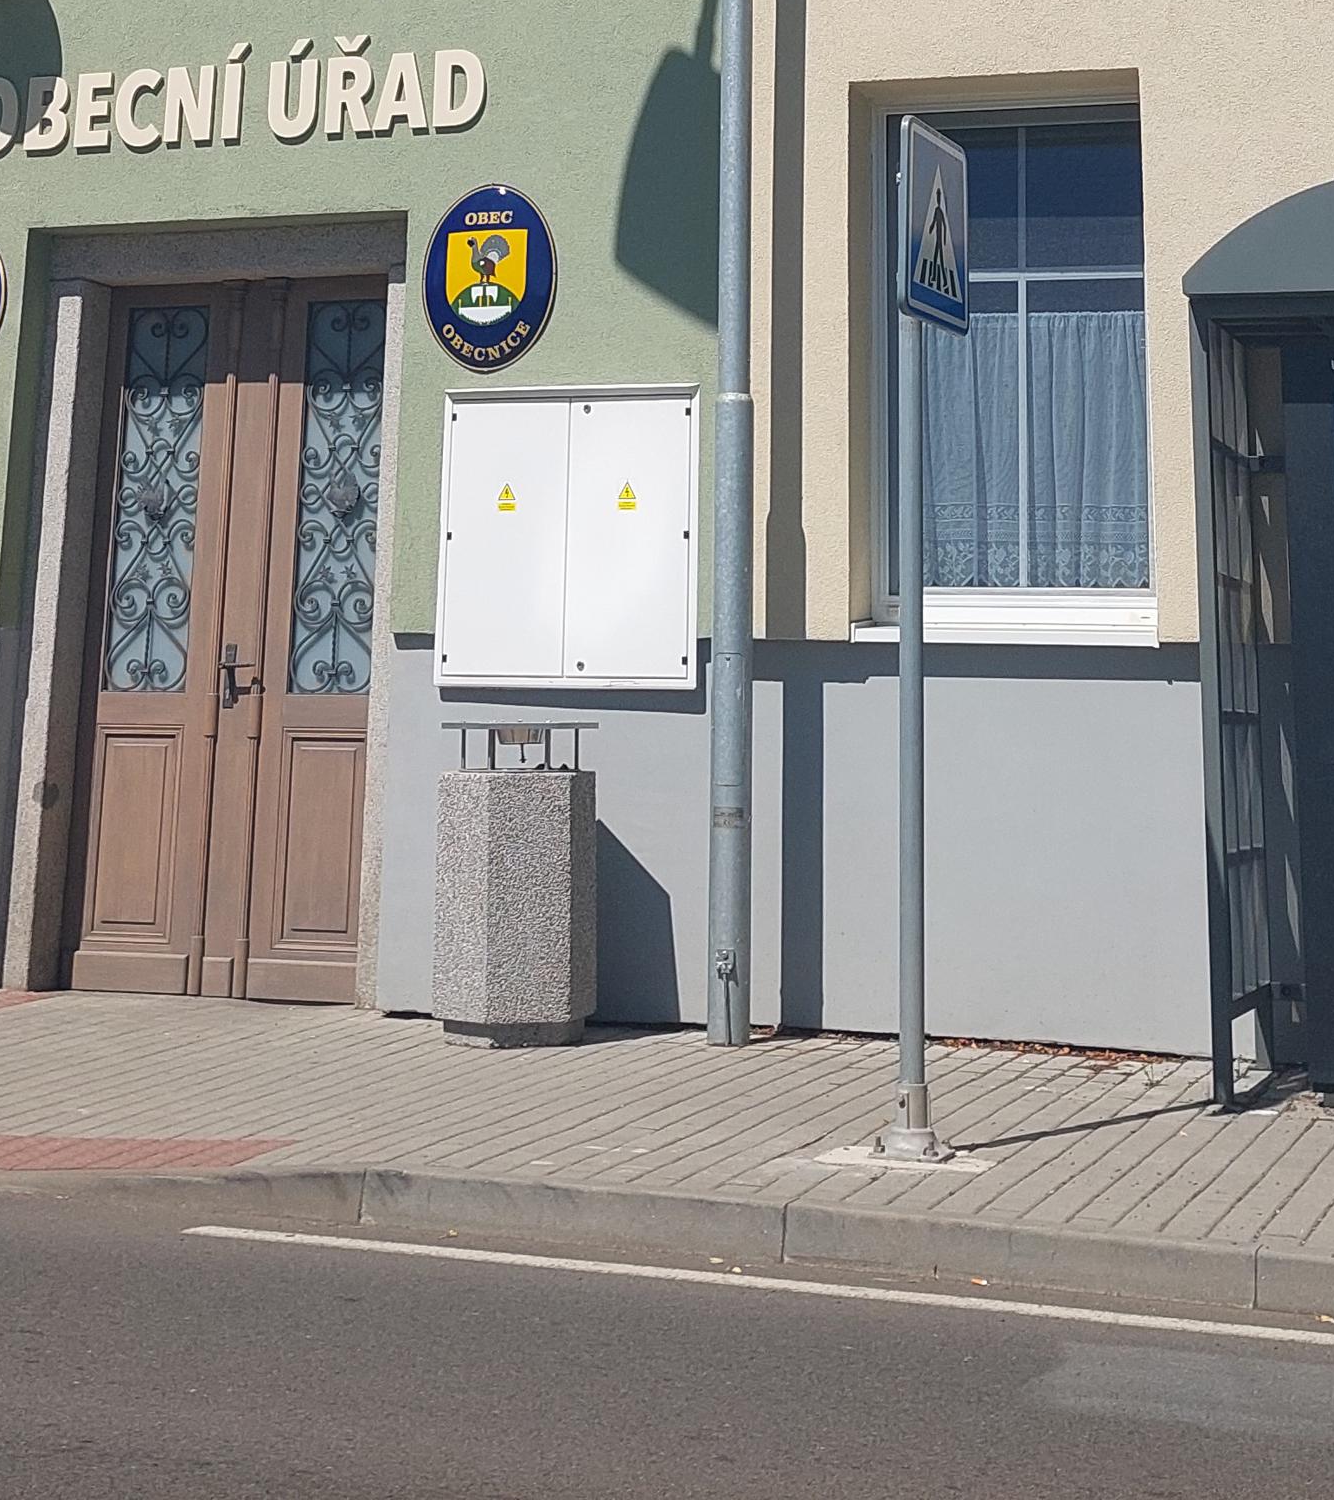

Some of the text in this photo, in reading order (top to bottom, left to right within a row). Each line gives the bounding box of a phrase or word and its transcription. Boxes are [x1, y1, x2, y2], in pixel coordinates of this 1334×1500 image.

[267, 34, 486, 140] ÚŘAD
[464, 210, 513, 226] OBEC
[442, 320, 531, 361] OBECNICE
